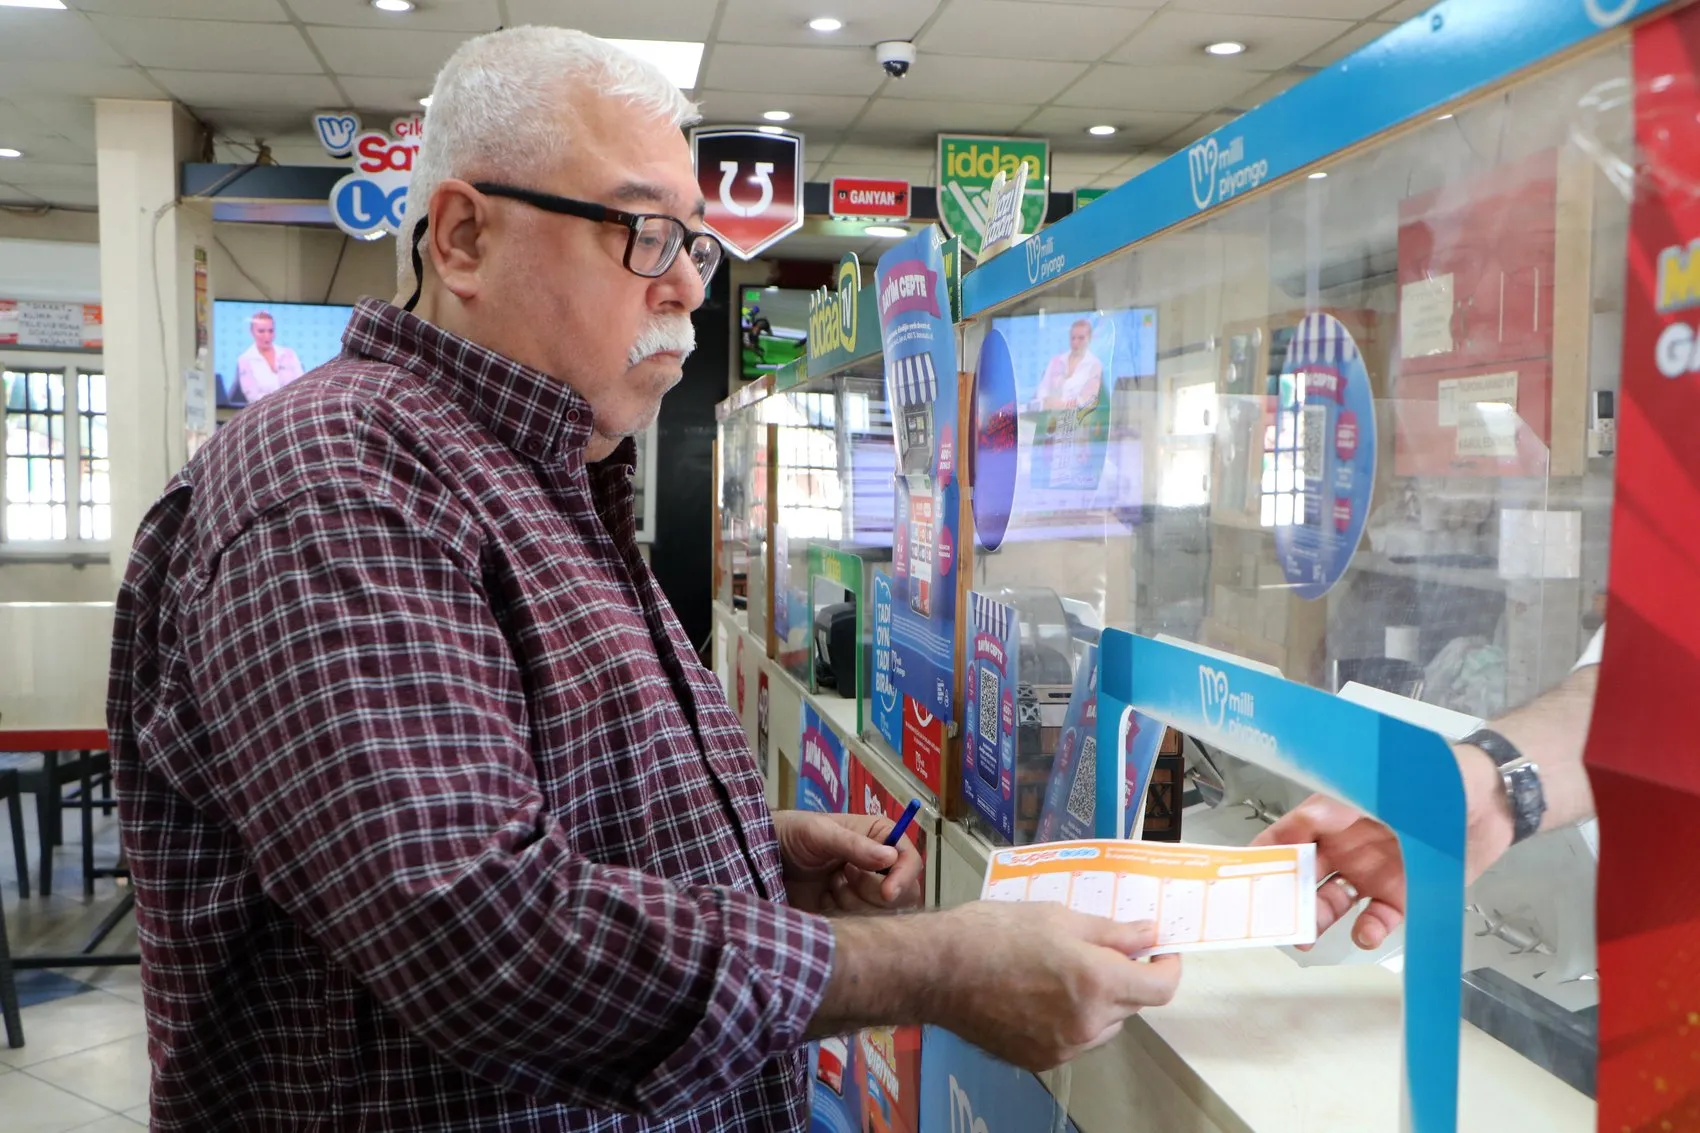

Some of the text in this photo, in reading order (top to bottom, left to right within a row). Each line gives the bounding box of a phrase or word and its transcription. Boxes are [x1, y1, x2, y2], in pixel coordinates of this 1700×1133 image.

[947, 144, 1040, 180] iddaa
[1219, 136, 1244, 170] milli
[1219, 159, 1267, 201] piyango
[850, 190, 896, 206] GANYAN
[1041, 254, 1065, 280] piyango
[899, 274, 927, 298] CEPTE
[841, 281, 852, 330] TV
[876, 625, 891, 647] OYN
[1228, 692, 1254, 718] milli
